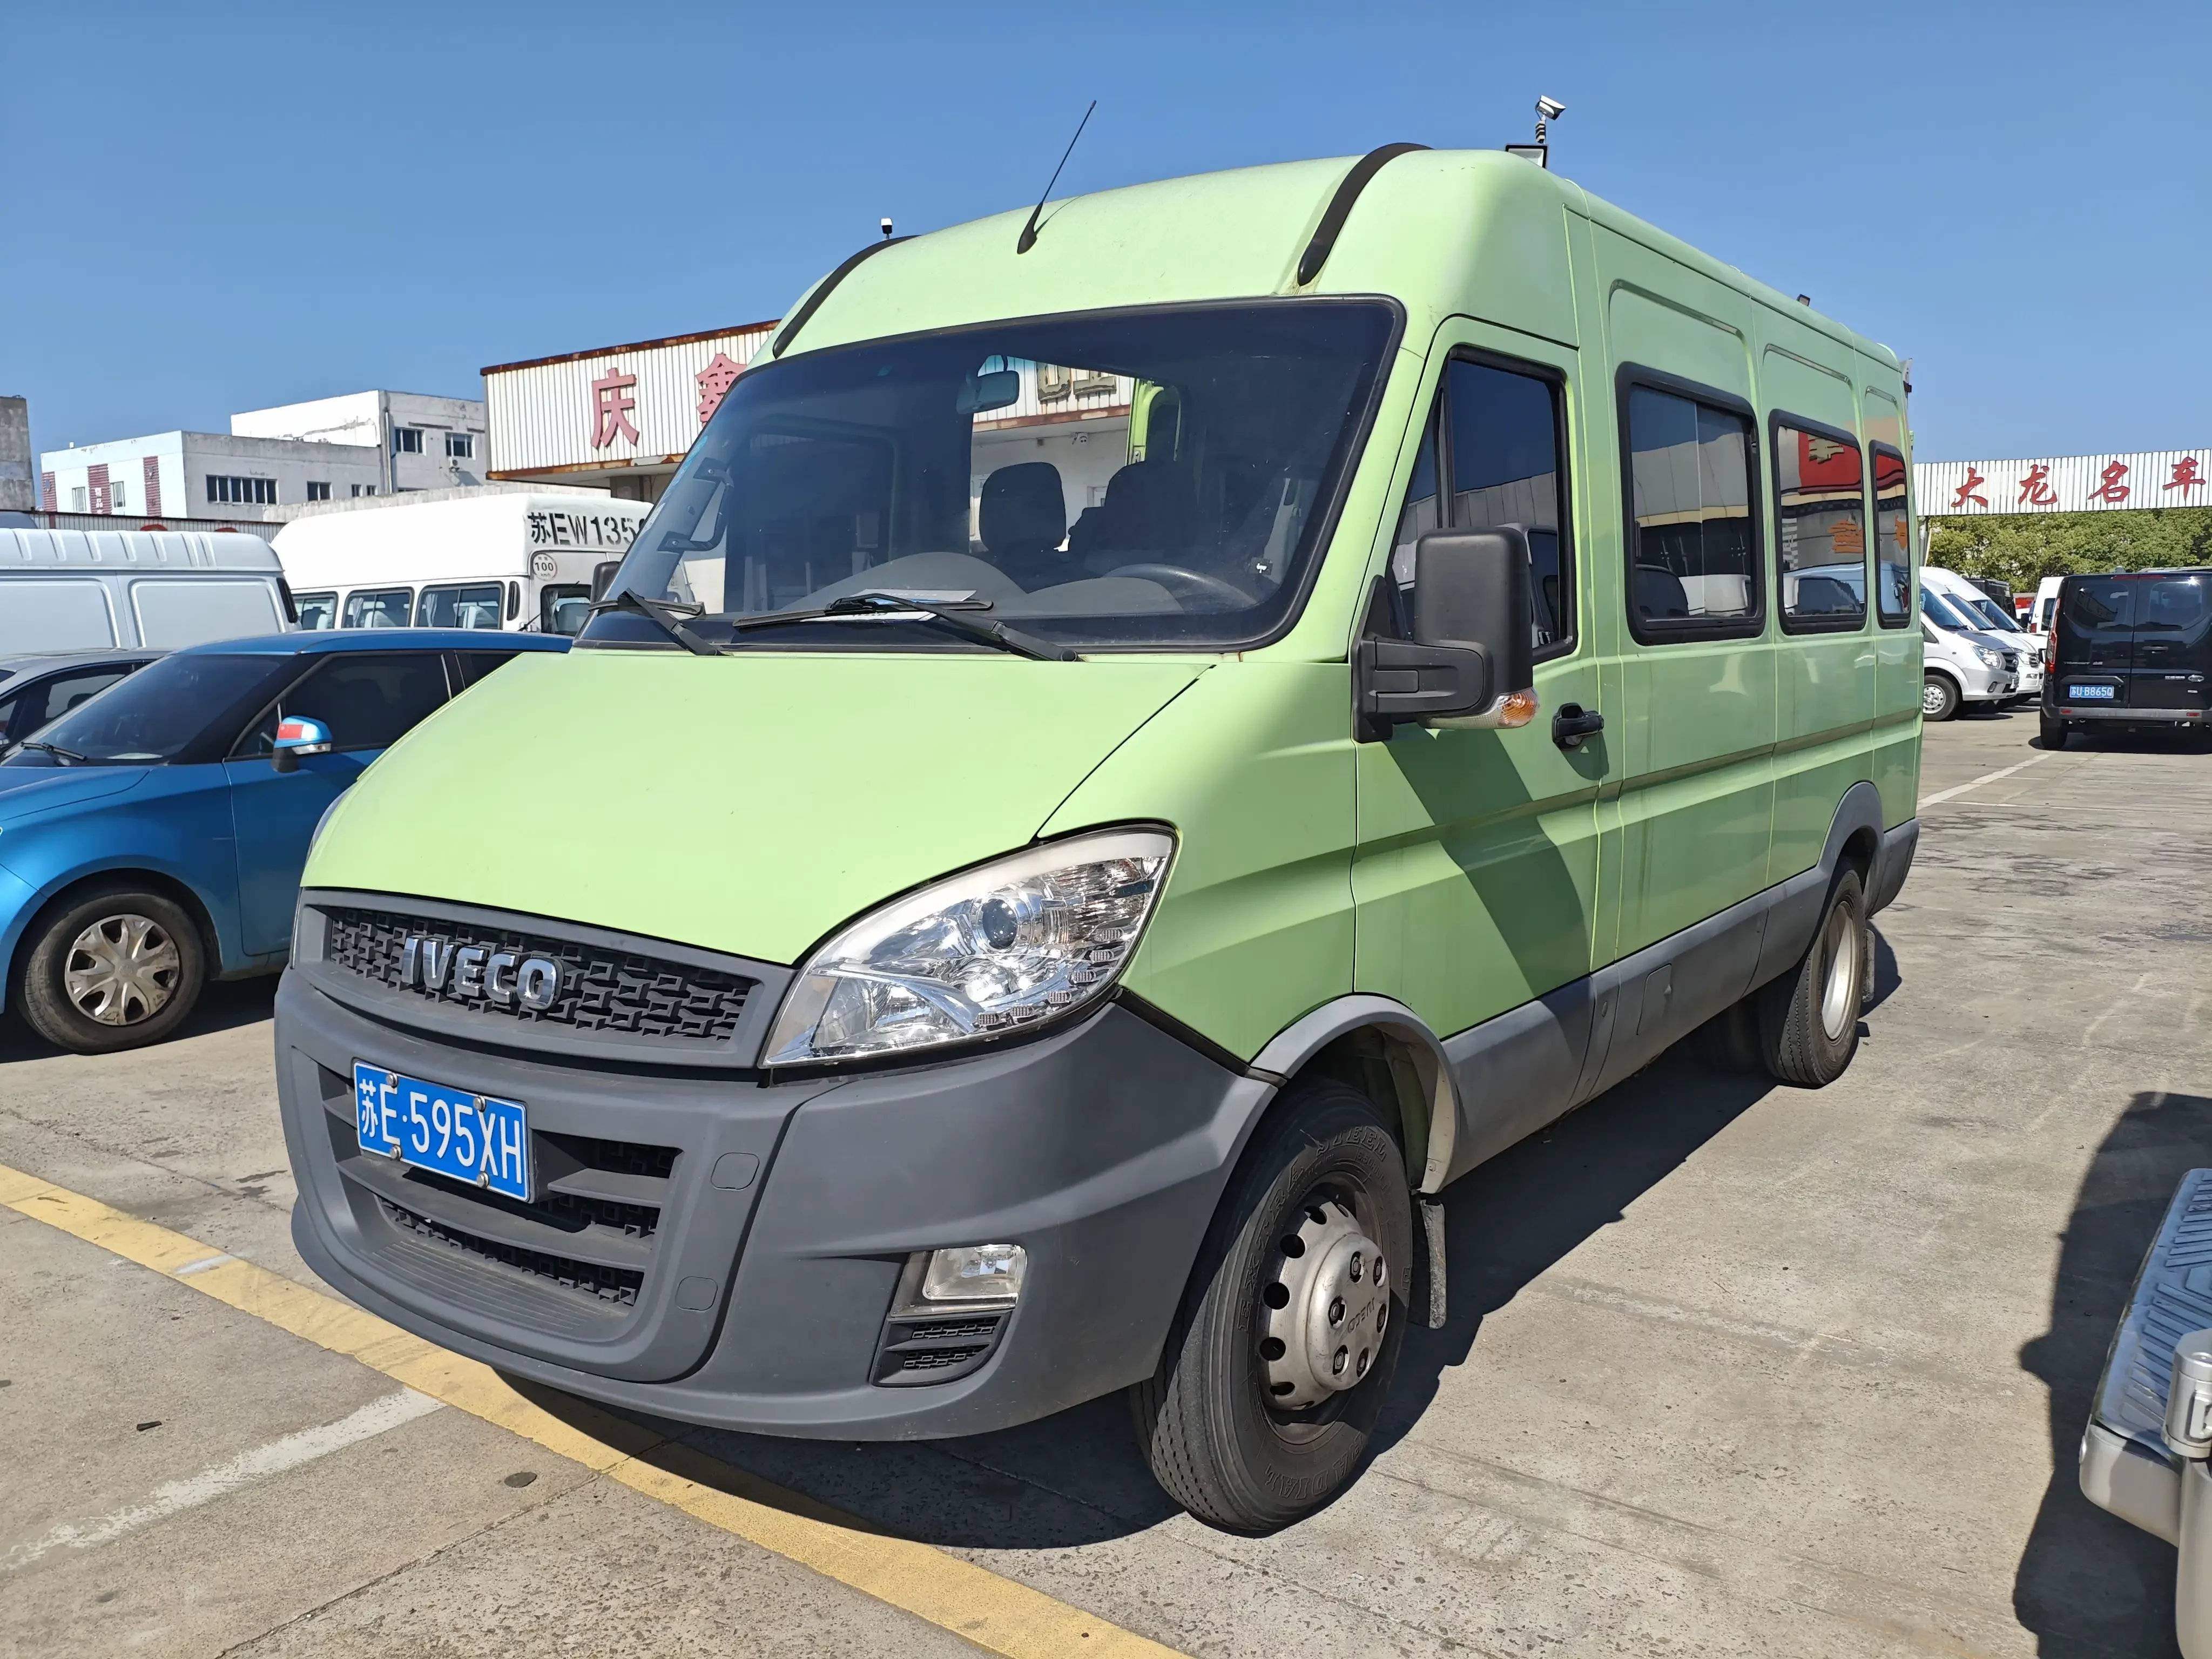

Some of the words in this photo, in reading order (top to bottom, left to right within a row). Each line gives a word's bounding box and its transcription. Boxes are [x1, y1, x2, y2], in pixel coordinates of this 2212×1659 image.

[1951, 456, 2206, 508] 大龙名车
[527, 512, 644, 545] 苏EW135
[535, 562, 554, 571] 100
[401, 937, 562, 1010] IVECO
[359, 1078, 522, 1184] 苏E·595XH
[1316, 1125, 1386, 1162] STEEL
[1347, 1297, 1375, 1334] IVECO
[1264, 1431, 1363, 1500] RADIAL
